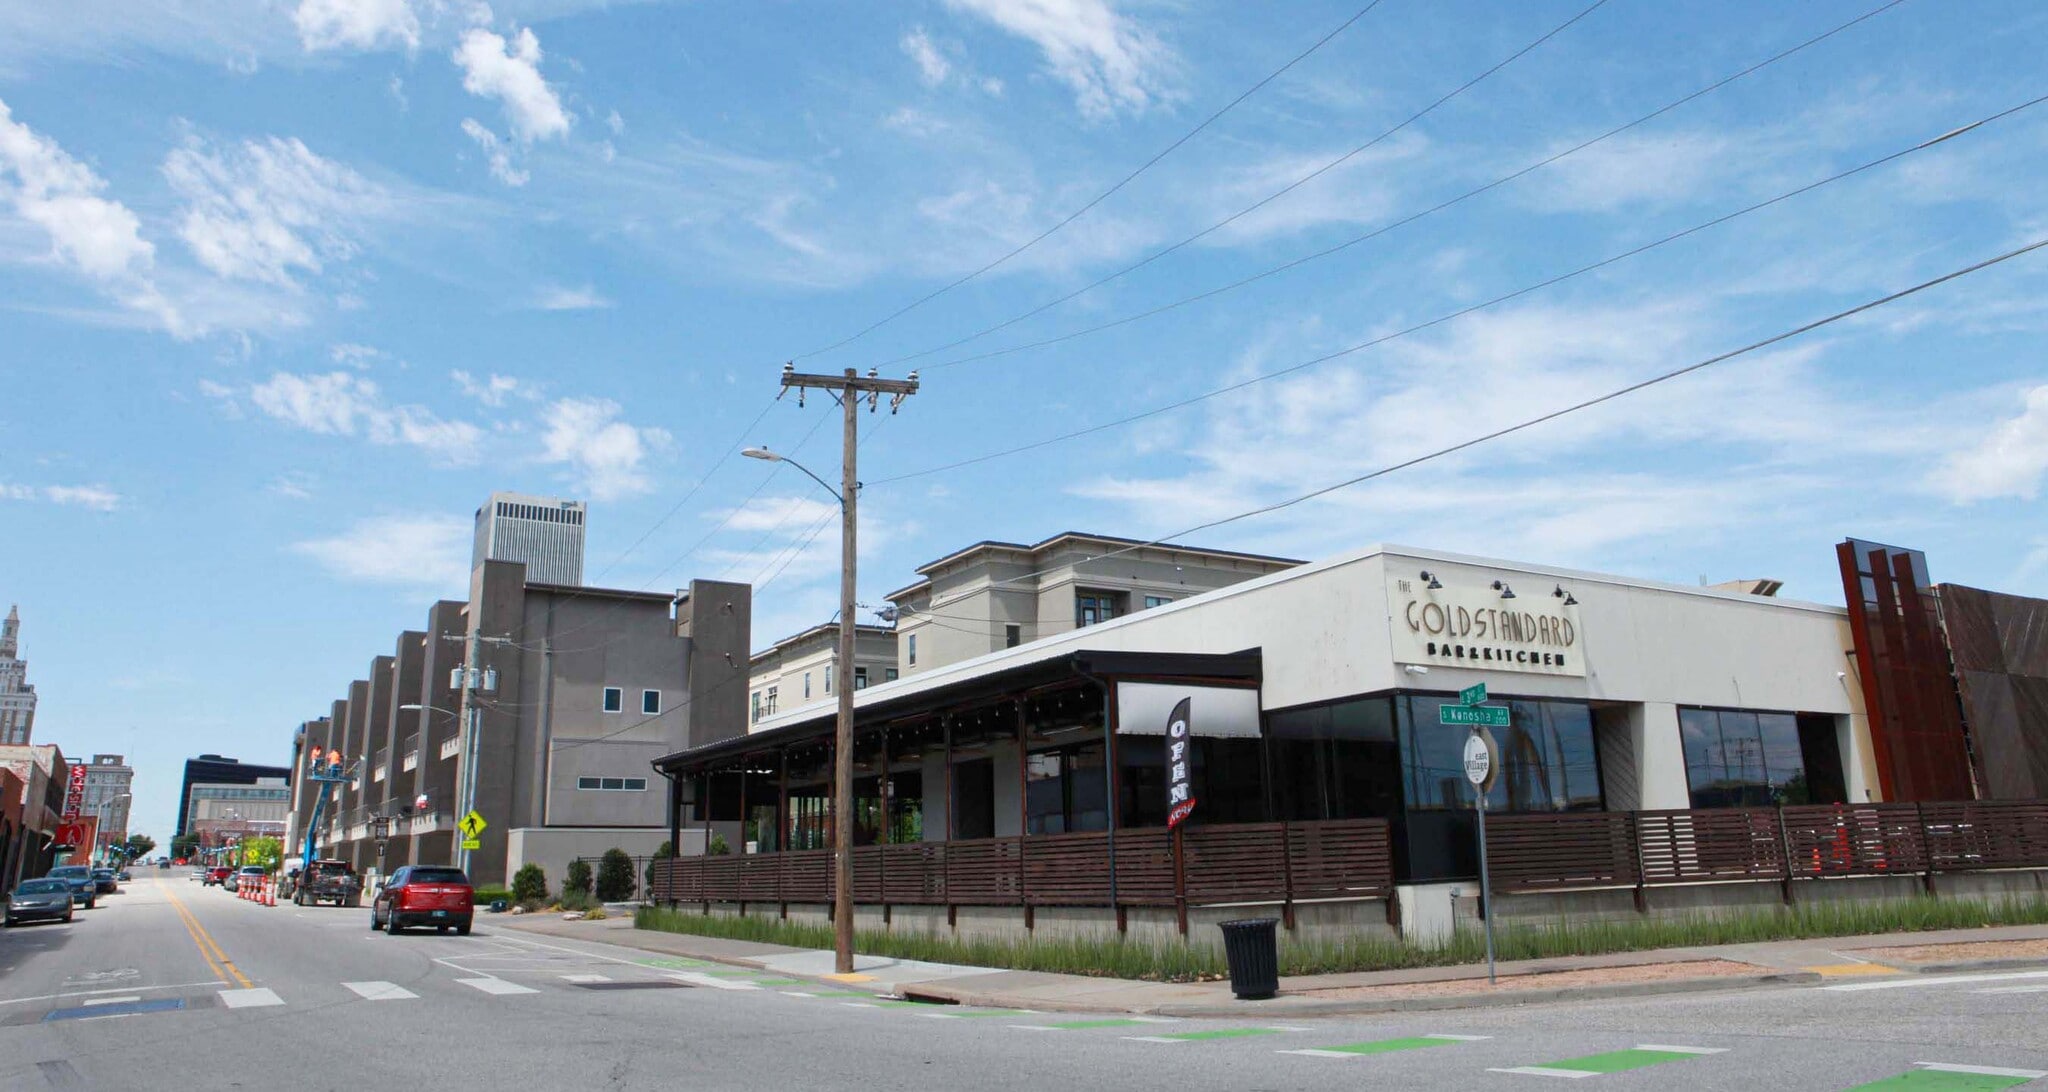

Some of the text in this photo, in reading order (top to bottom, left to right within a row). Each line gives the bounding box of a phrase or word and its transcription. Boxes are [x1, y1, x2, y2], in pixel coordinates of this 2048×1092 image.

[1398, 580, 1411, 593] THE
[1406, 600, 1574, 647] GOLDSTANDARD
[1451, 709, 1491, 721] Kenosha
[1171, 720, 1188, 805] OPEN
[1465, 760, 1487, 772] Village
